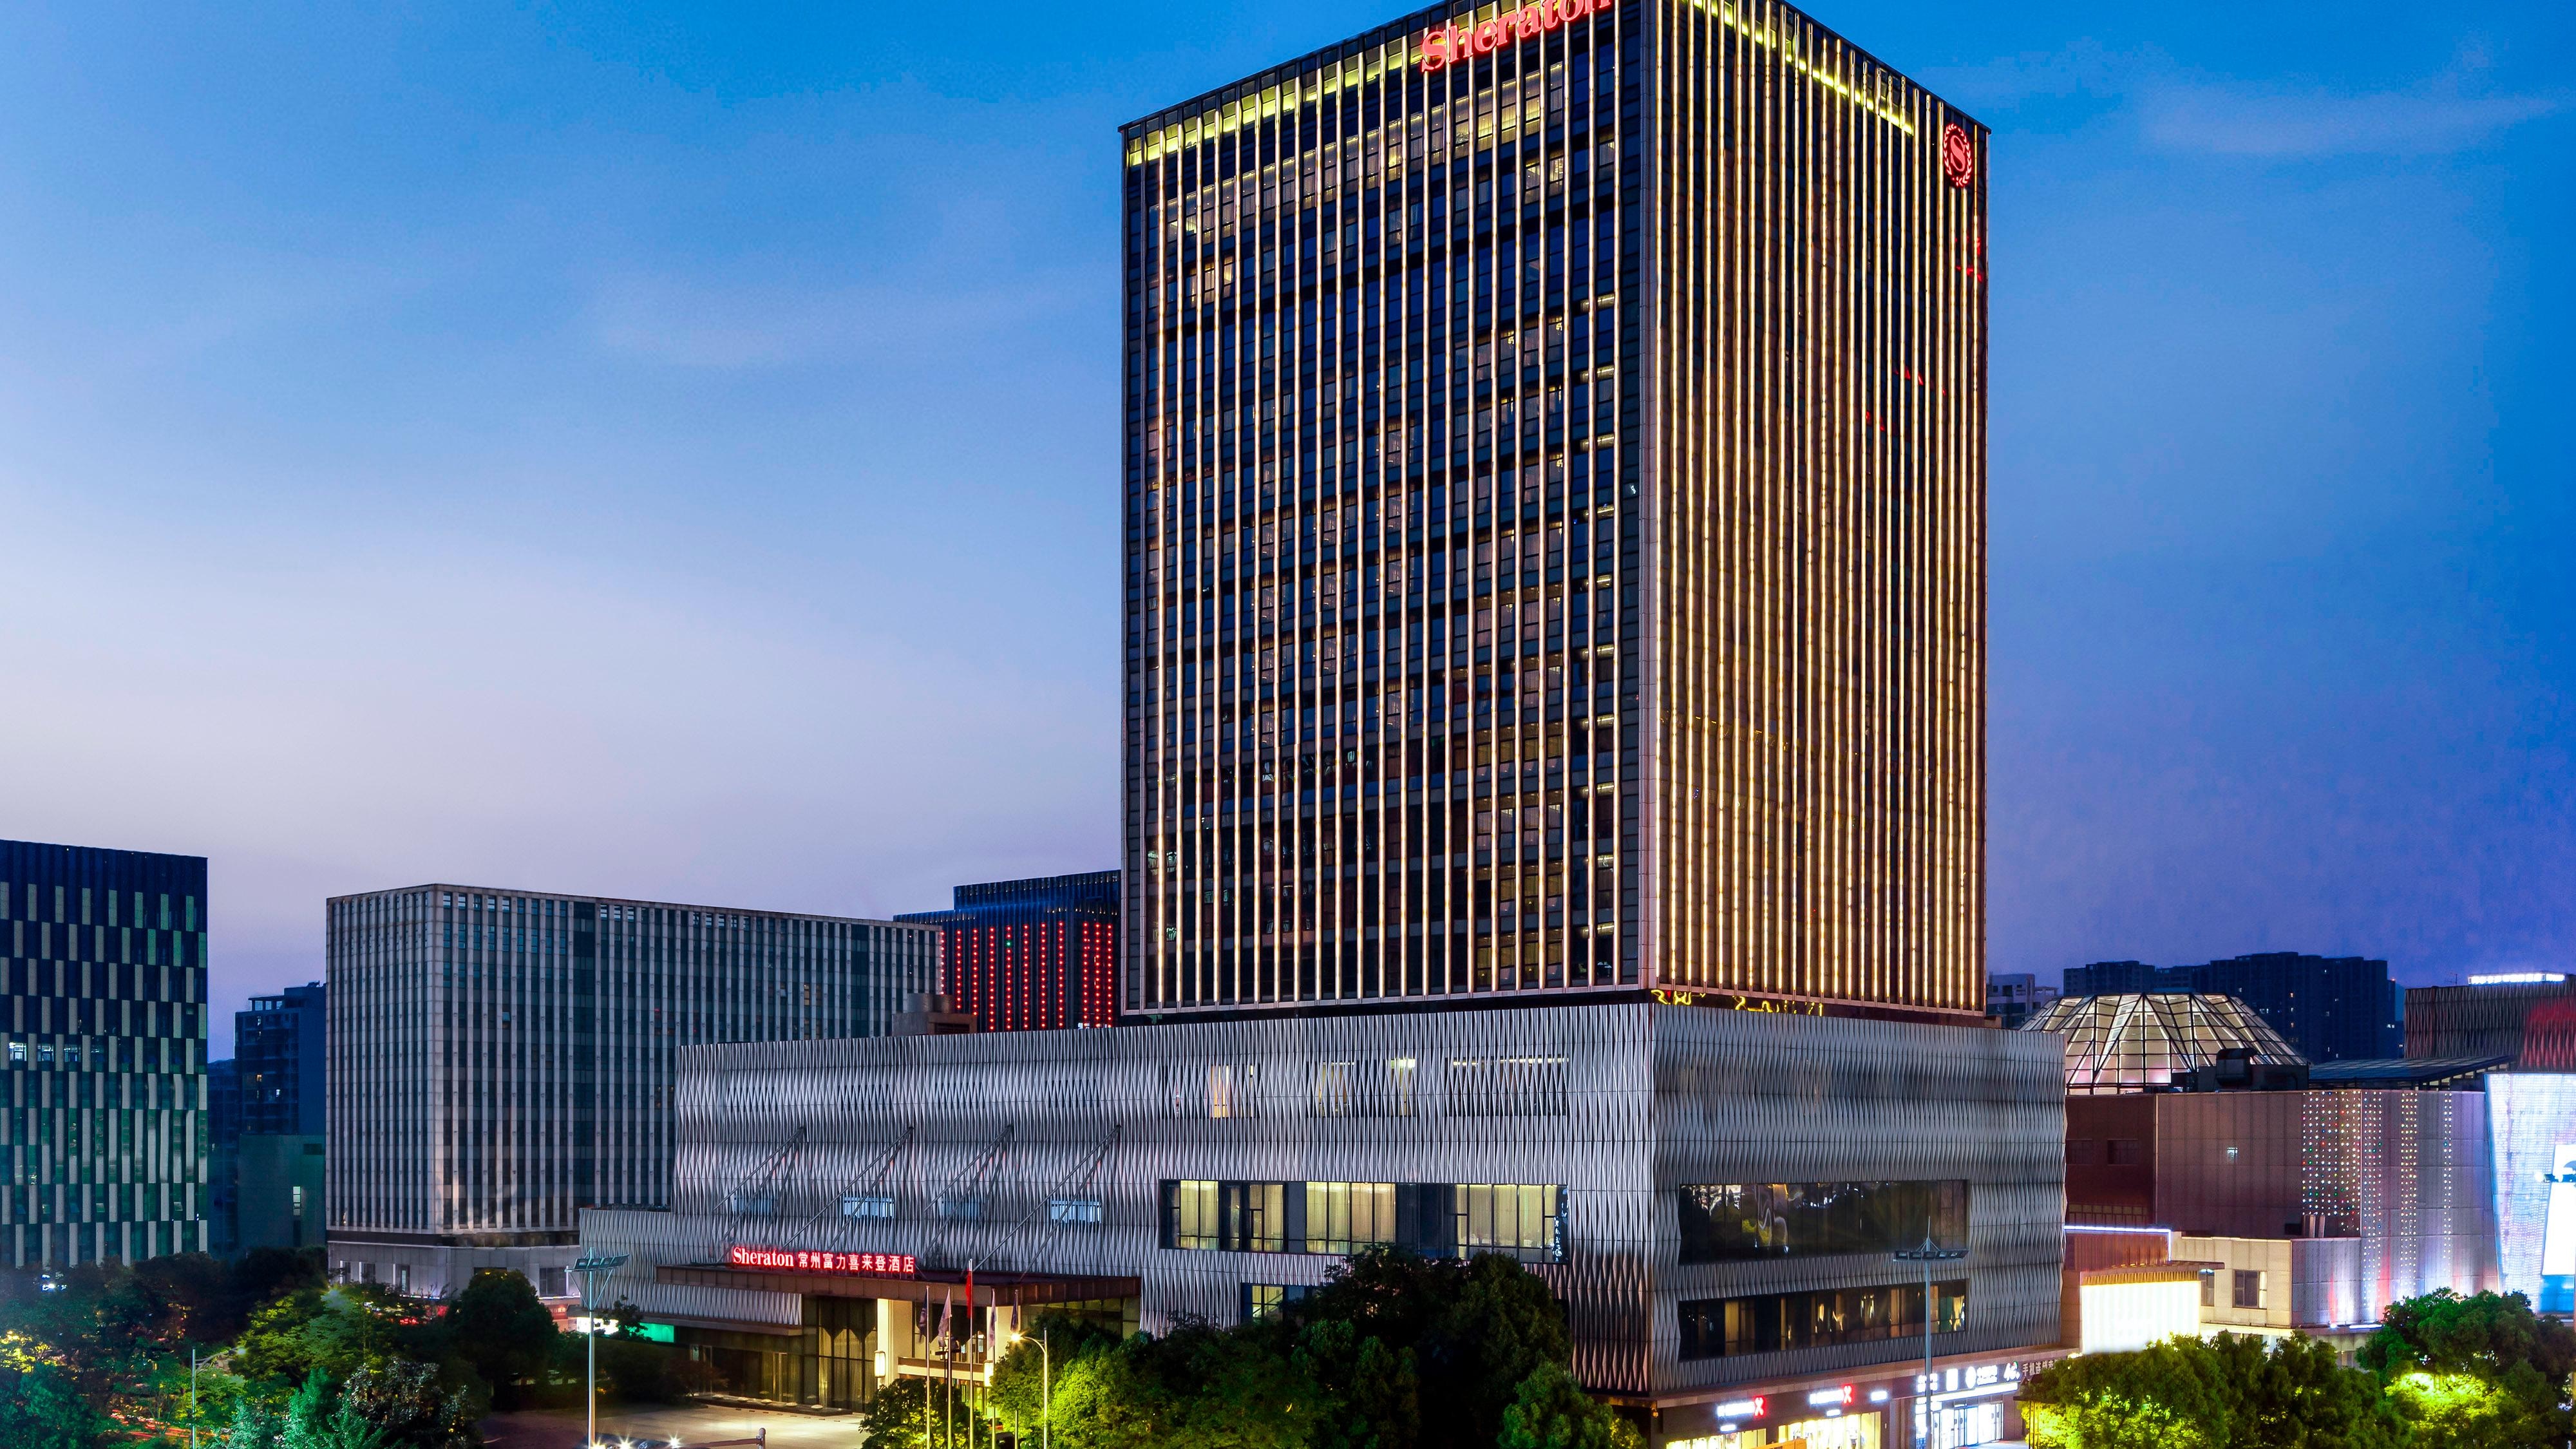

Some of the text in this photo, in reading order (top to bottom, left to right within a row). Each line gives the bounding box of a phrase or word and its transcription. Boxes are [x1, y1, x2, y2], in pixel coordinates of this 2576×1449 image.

[733, 1246, 914, 1274] Sheraton 常州富力喜来登酒店
